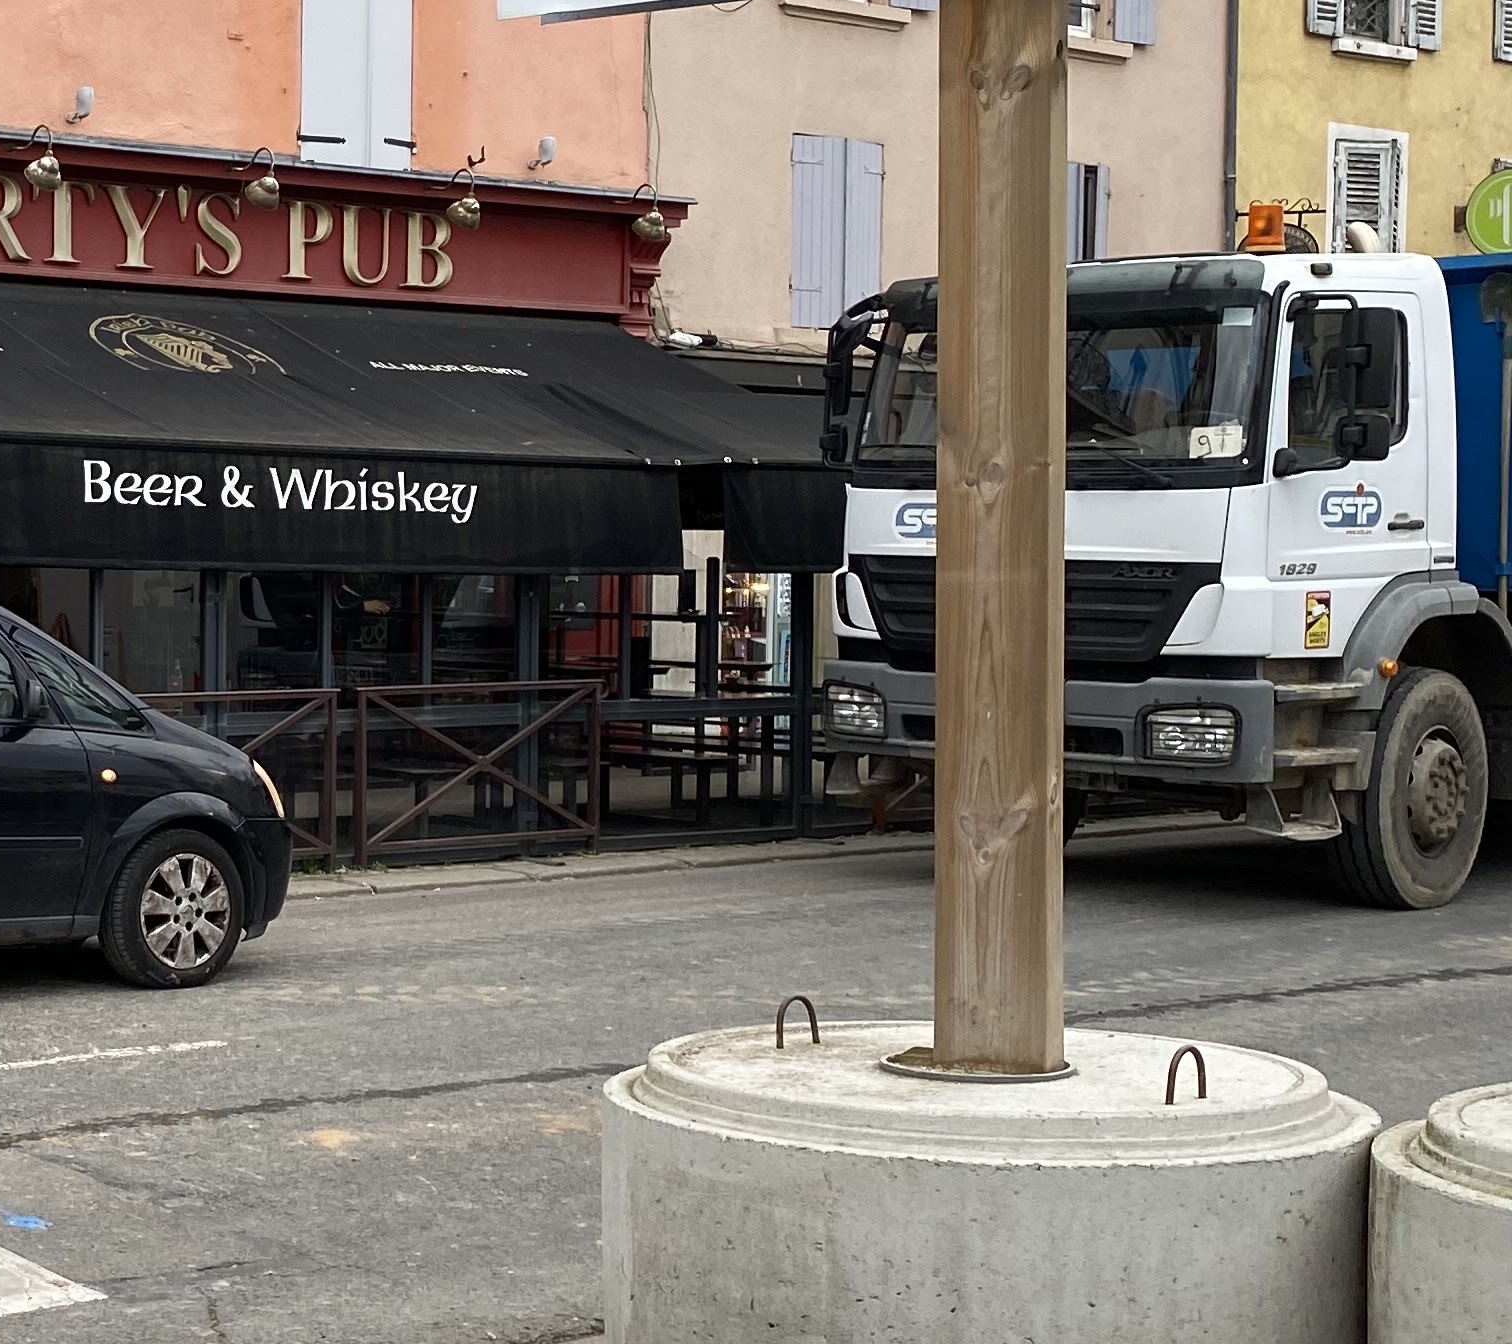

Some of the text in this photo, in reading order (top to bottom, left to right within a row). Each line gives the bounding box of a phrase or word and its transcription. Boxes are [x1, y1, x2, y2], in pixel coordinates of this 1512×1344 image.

[283, 200, 455, 291] PUB
[220, 465, 257, 511] &
[270, 467, 479, 524] Whiskey
[896, 507, 937, 533] SC
[1111, 564, 1177, 579] AXOR
